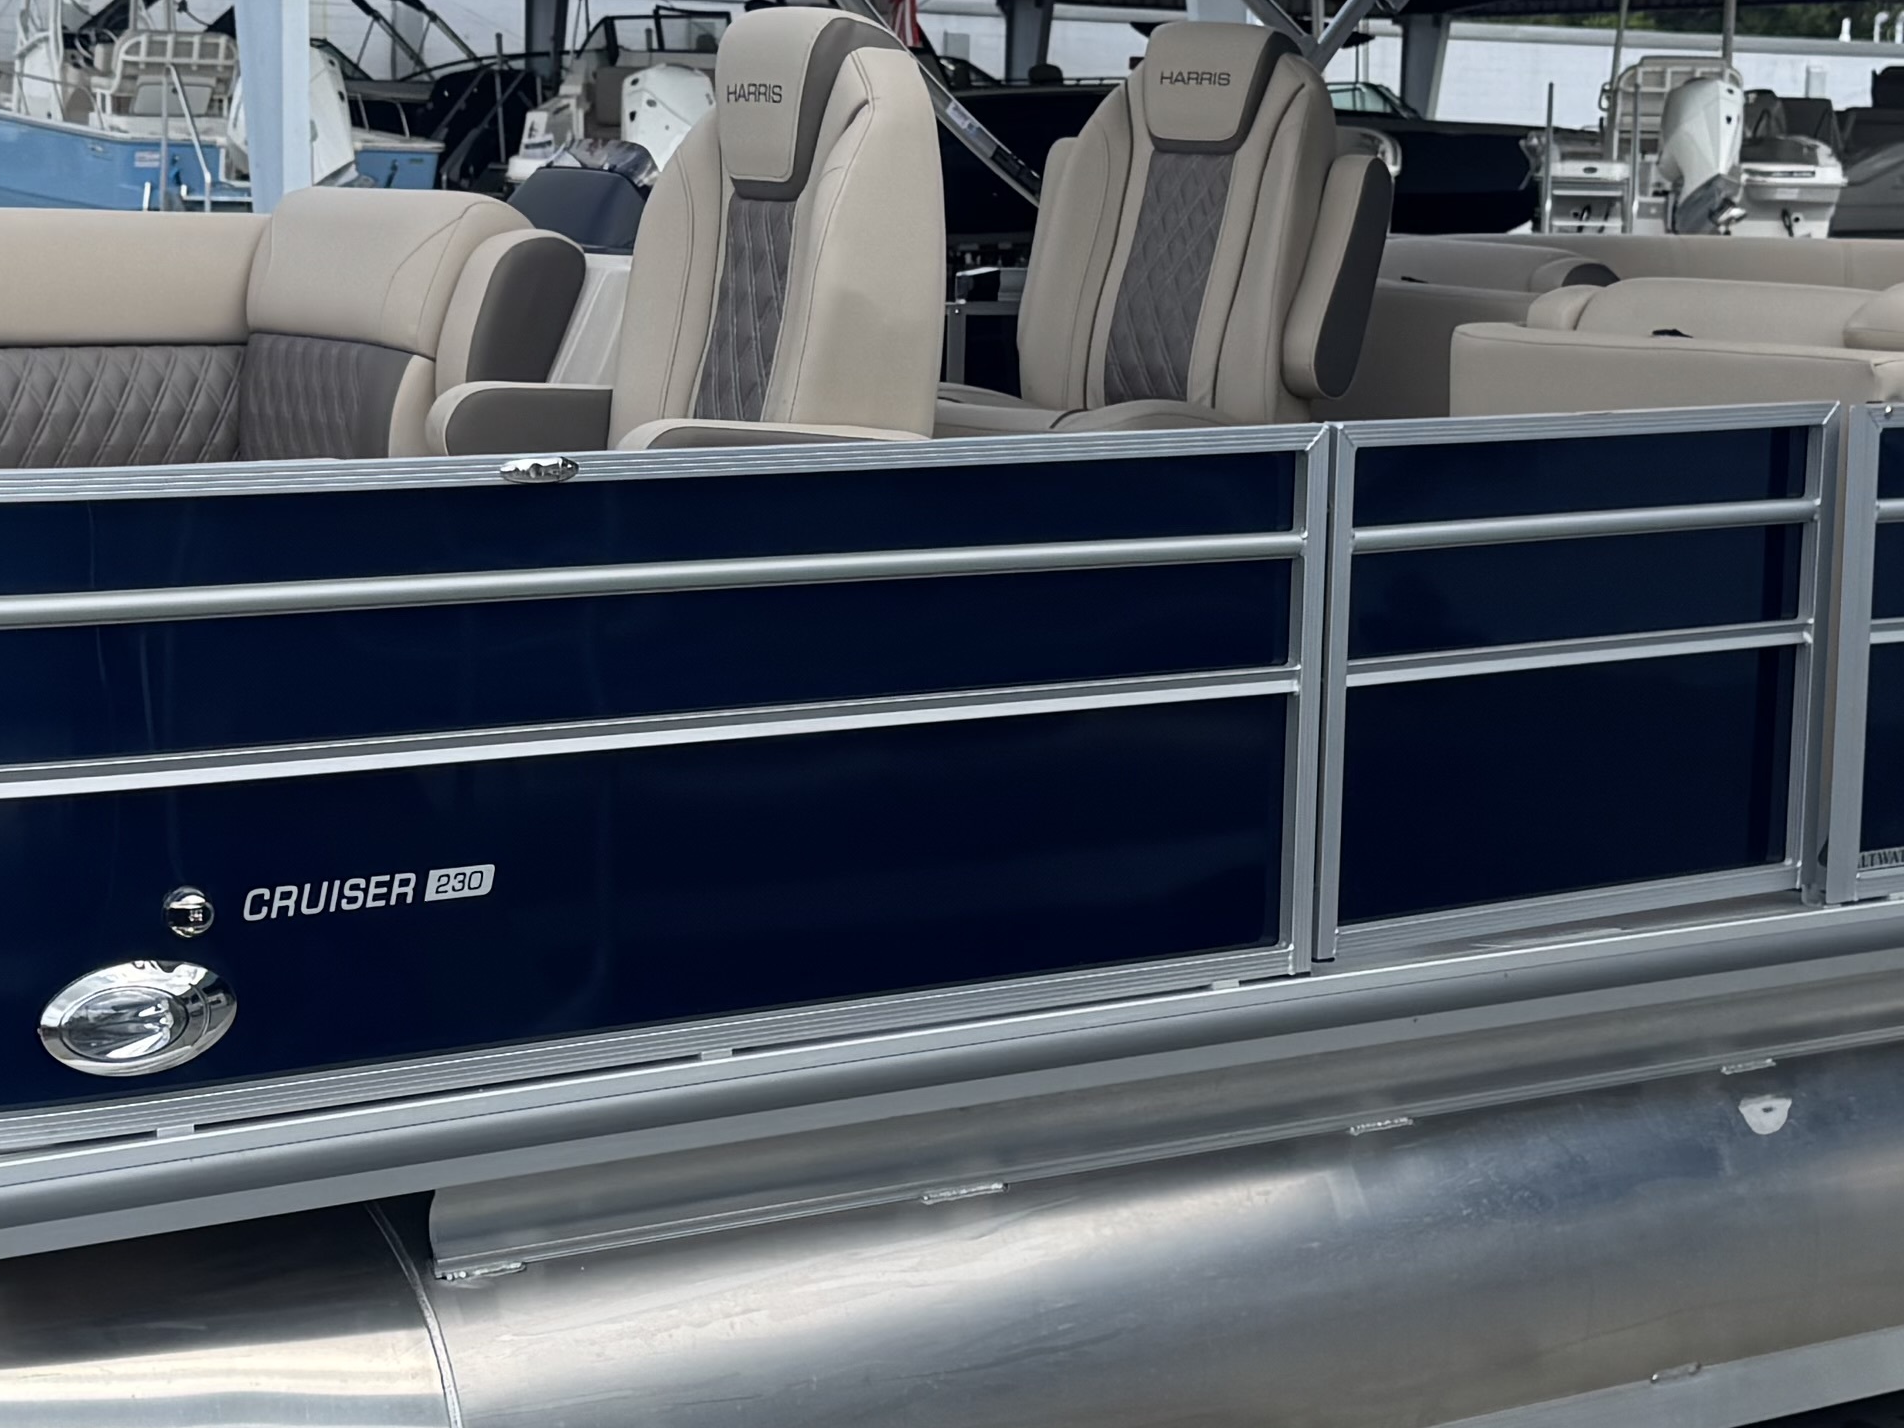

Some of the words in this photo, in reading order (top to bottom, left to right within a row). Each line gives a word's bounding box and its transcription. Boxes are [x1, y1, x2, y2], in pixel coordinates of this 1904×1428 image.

[1159, 70, 1232, 87] HARRIS
[726, 83, 783, 104] HARRIS
[242, 872, 417, 922] CRUISER
[434, 870, 484, 894] 230
